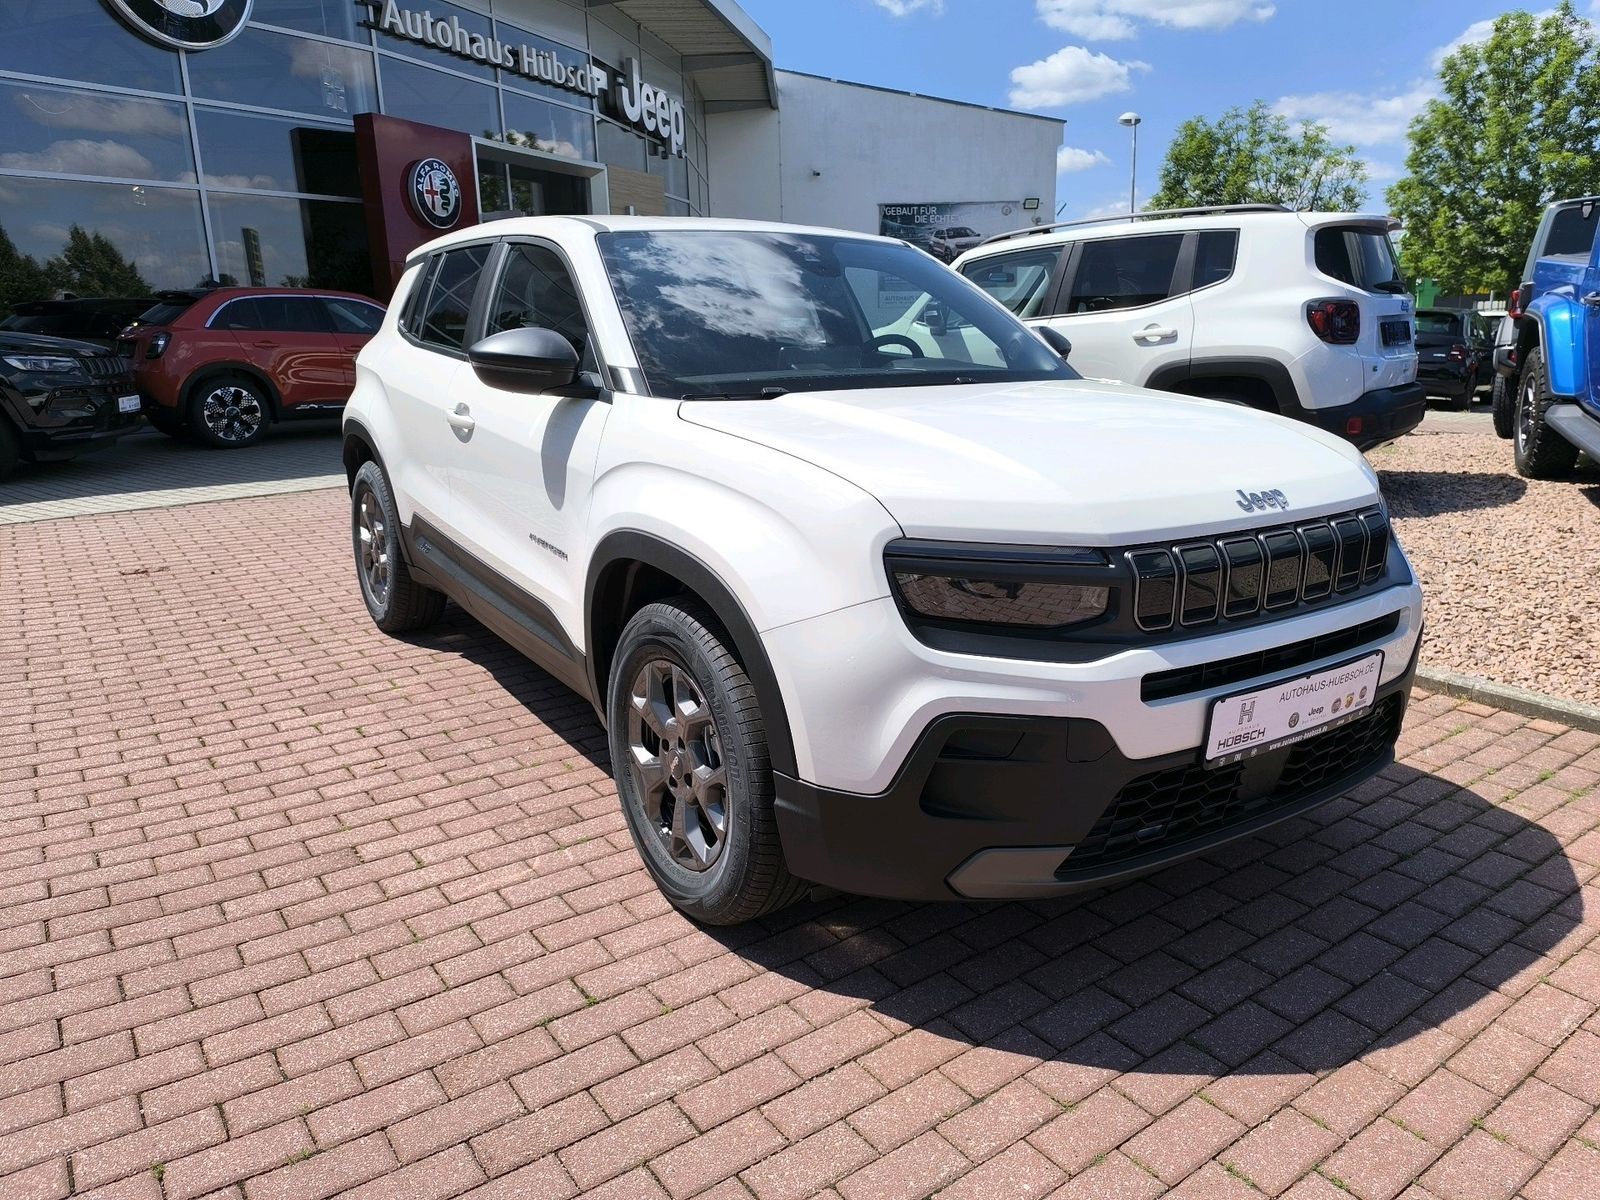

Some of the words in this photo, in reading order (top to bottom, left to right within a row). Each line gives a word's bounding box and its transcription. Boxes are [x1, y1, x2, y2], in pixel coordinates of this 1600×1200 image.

[381, 0, 515, 69] Autohaus
[520, 44, 599, 97] Hübsch
[620, 57, 685, 156] Jeep
[417, 165, 431, 191] ALFA
[433, 162, 459, 197] ROMEO
[885, 206, 918, 216] GEBAUT
[920, 204, 937, 215] FÜR
[915, 215, 928, 224] DIE
[1236, 489, 1289, 513] Jeep
[1279, 662, 1375, 704] AUTOHAUS-HUEBSCH.DE
[1308, 706, 1325, 716] Jeep
